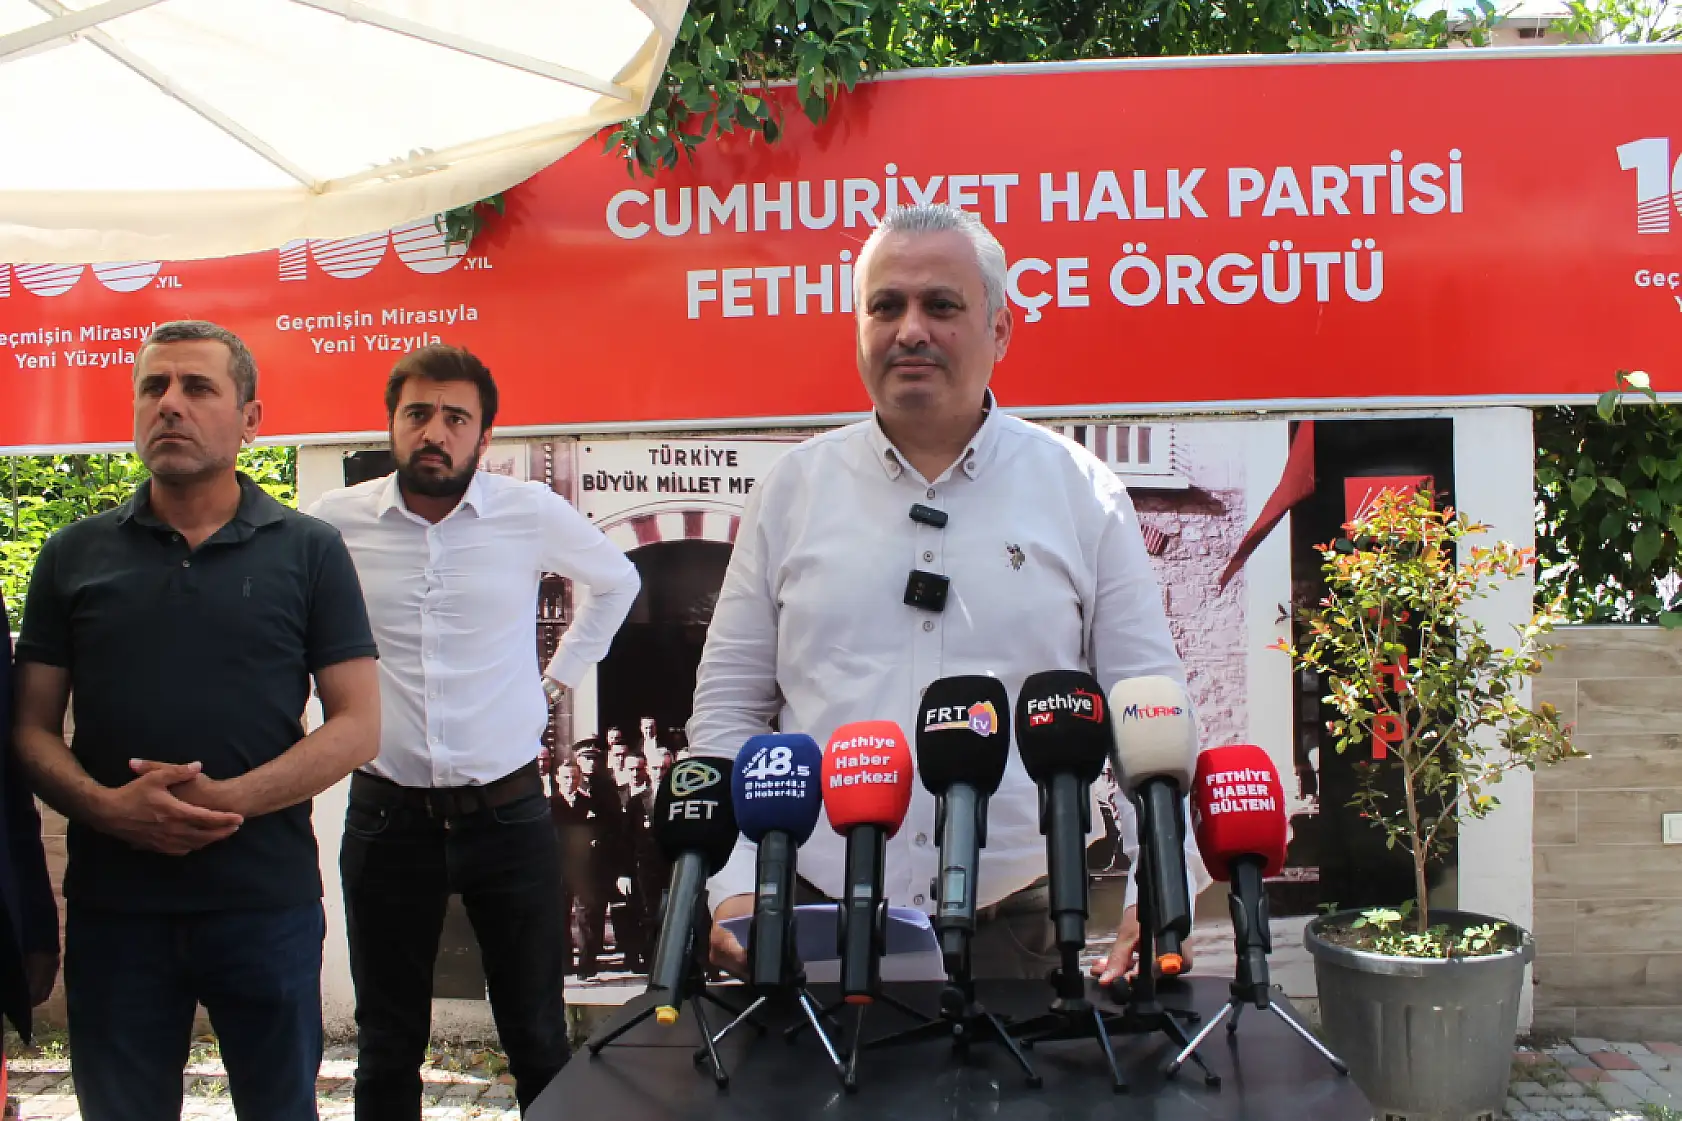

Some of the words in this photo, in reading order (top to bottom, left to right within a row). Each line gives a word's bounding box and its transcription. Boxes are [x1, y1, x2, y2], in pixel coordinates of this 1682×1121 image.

[606, 163, 1018, 239] CUMHURİYET
[1040, 167, 1208, 222] HALK
[1229, 148, 1463, 217] PARTİSİ
[686, 249, 853, 319] FETHİ
[1006, 257, 1089, 322] ÇE
[1109, 238, 1383, 306] ÖRGÜTÜ
[276, 311, 373, 332] Geçmişin
[382, 304, 478, 325] Mirasıyla
[80, 322, 156, 344] Mirasıyl
[311, 336, 356, 354] Yeni
[364, 332, 441, 353] Yüzyıla
[15, 352, 56, 369] Yeni
[64, 348, 135, 368] Yüzyıla
[649, 444, 738, 466] TÜRKİYE
[582, 470, 648, 491] BÜYÜK
[657, 472, 721, 493] MİLLET
[729, 477, 755, 493] ME
[1028, 694, 1092, 714] Fethiye
[926, 706, 966, 724] FRT
[973, 716, 988, 730] tv
[1033, 713, 1050, 724] TV
[832, 736, 896, 752] Fethiye
[835, 754, 891, 769] Haber
[829, 770, 898, 788] Merkezi
[1206, 768, 1272, 786] FETHİYE
[1213, 784, 1268, 799] HABER
[668, 800, 718, 821] FET
[1210, 796, 1275, 815] BÜLTENİ
